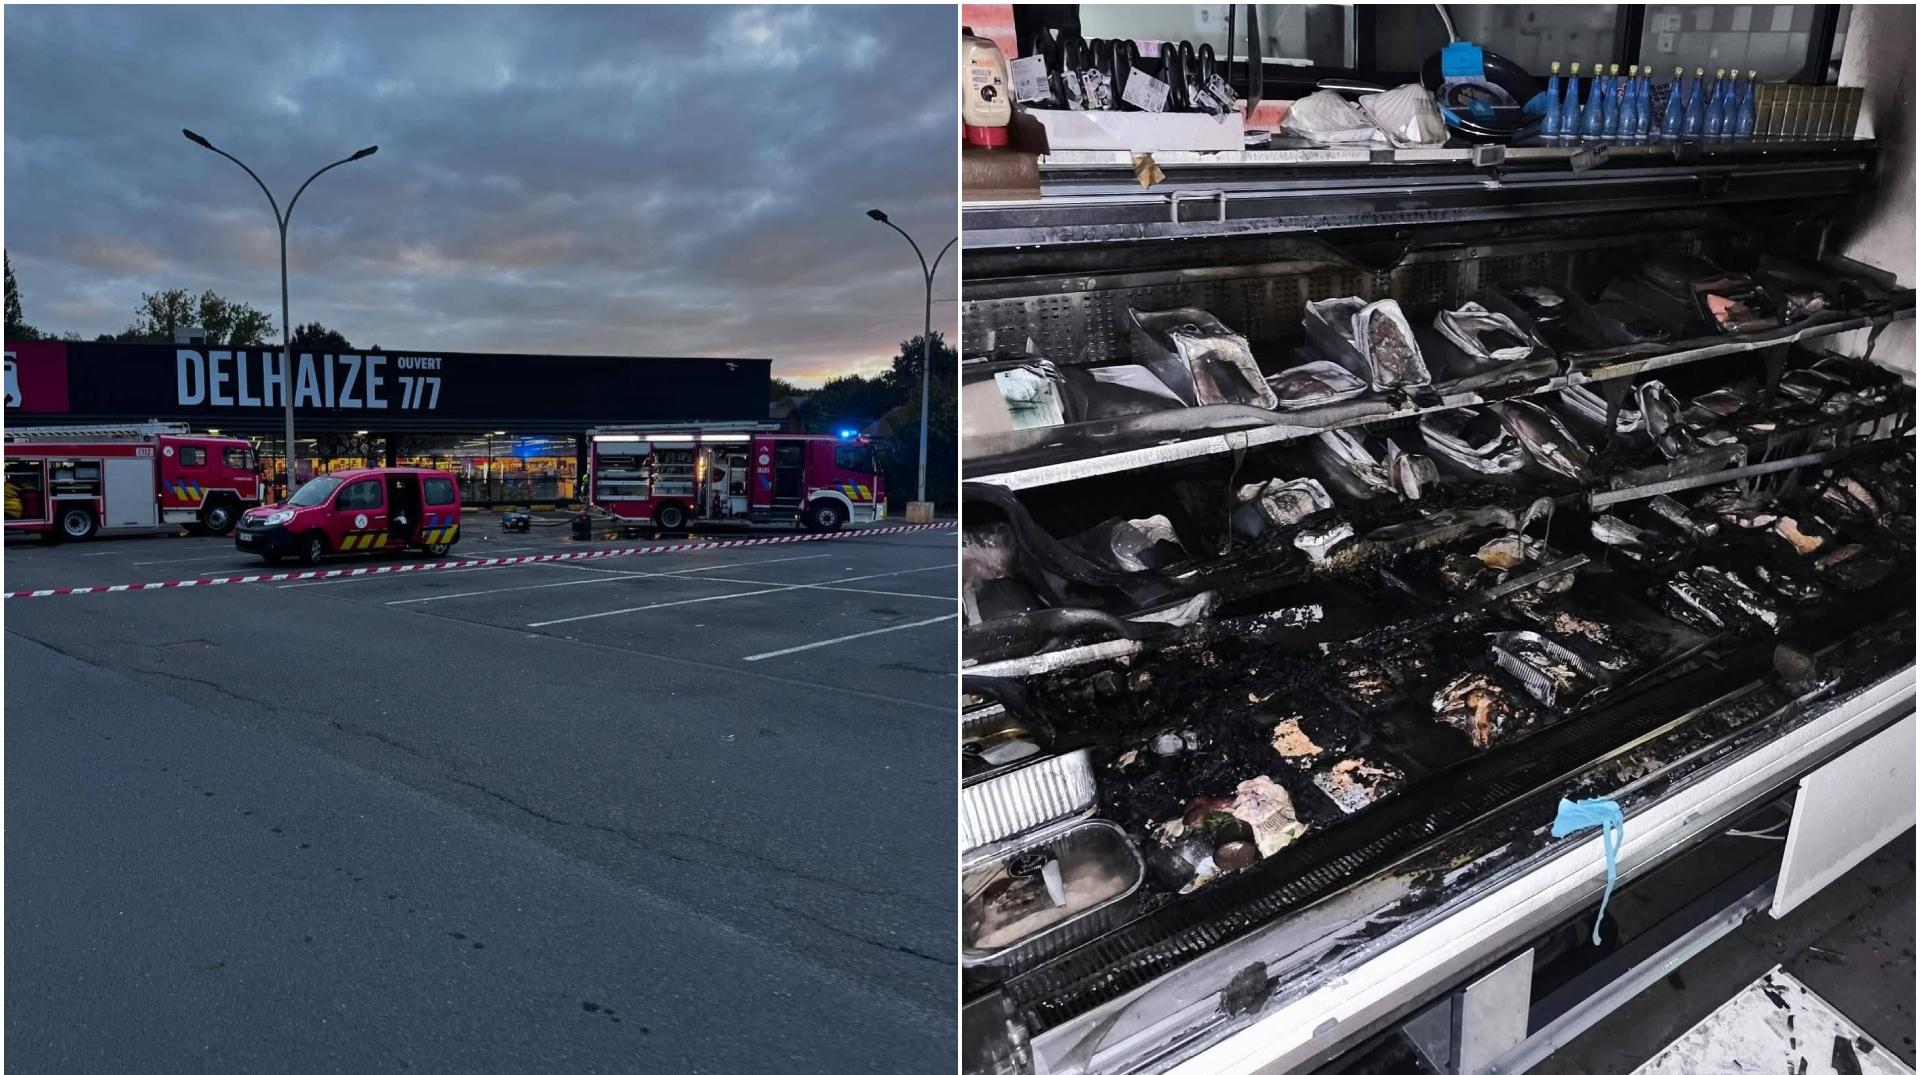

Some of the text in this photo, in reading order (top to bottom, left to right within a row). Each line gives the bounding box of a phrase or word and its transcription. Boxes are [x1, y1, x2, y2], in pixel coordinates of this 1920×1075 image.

[176, 349, 388, 409] DELHAIZE
[397, 356, 442, 370] OUVERT
[398, 376, 441, 409] 7/7
